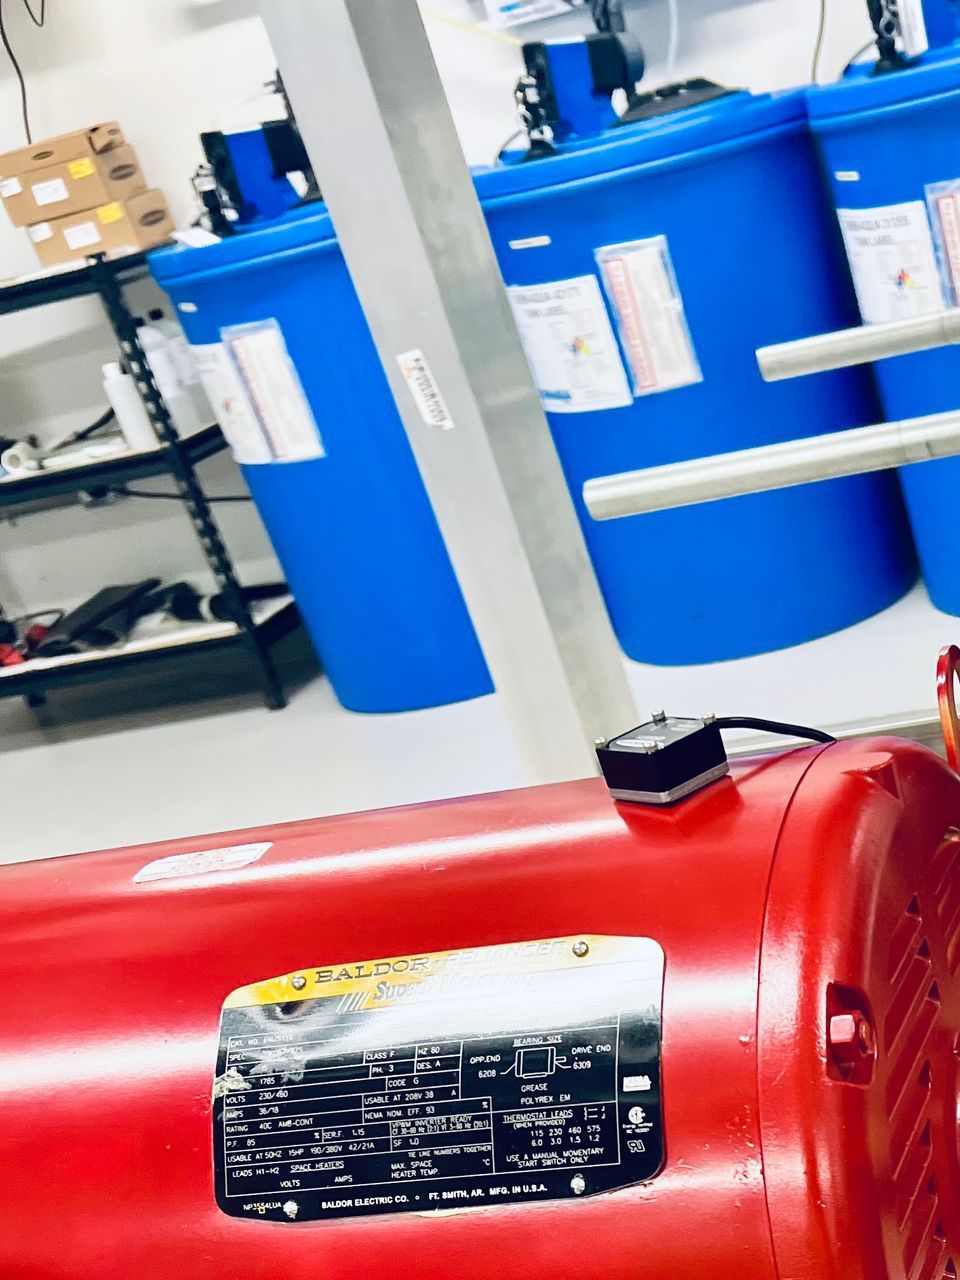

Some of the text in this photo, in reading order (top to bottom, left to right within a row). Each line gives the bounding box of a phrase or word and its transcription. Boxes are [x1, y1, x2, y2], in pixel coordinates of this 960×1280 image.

[314, 957, 431, 984] BALDOR
[513, 1034, 563, 1046] BEARING SIZE
[431, 1046, 440, 1054] 60
[571, 1044, 611, 1055] DRIVE END
[366, 1052, 387, 1061] CLASS
[573, 1060, 592, 1070] 6309
[478, 1069, 497, 1078] 6208
[260, 1077, 276, 1085] 1765
[388, 1078, 407, 1087] CODE
[520, 1083, 548, 1092] GREASE
[225, 1090, 289, 1104] VOLTS 230/460
[364, 1095, 389, 1105] USABLE
[405, 1091, 423, 1100] 208V
[425, 1090, 434, 1099] 38
[520, 1093, 571, 1105] POLYREX EM
[226, 1106, 279, 1119] AMPS 36/18
[364, 1111, 383, 1120] NEMA
[426, 1106, 435, 1114] 93
[503, 1109, 574, 1123] THERMOSTAT LEADS
[415, 1118, 447, 1127] INVERTER
[450, 1115, 472, 1123] READY
[226, 1124, 249, 1133] RATING
[530, 1125, 601, 1138] 115 230 460 575
[531, 1134, 600, 1147] 6.0 3.0 1.5 1.2
[433, 1148, 461, 1156] NUMBERS
[463, 1144, 492, 1153] TOGETHER
[506, 1154, 520, 1163] USE
[532, 1151, 559, 1160] MANUAL
[562, 1147, 605, 1157] MOMENTARY
[227, 1153, 252, 1162] USABLE
[517, 1155, 589, 1169] START SWITCH ONLY
[232, 1168, 253, 1178] LEADS
[290, 1162, 312, 1172] SPACE
[315, 1160, 345, 1170] HEATERS
[410, 1159, 433, 1169] SPACE
[391, 1170, 417, 1179] HEATER
[279, 1174, 354, 1189] VOLTS AMPS
[321, 1183, 548, 1209] BALDOR ELECTRIC CO. FT. SMITH, AR. MFG. IN U.S.A.
